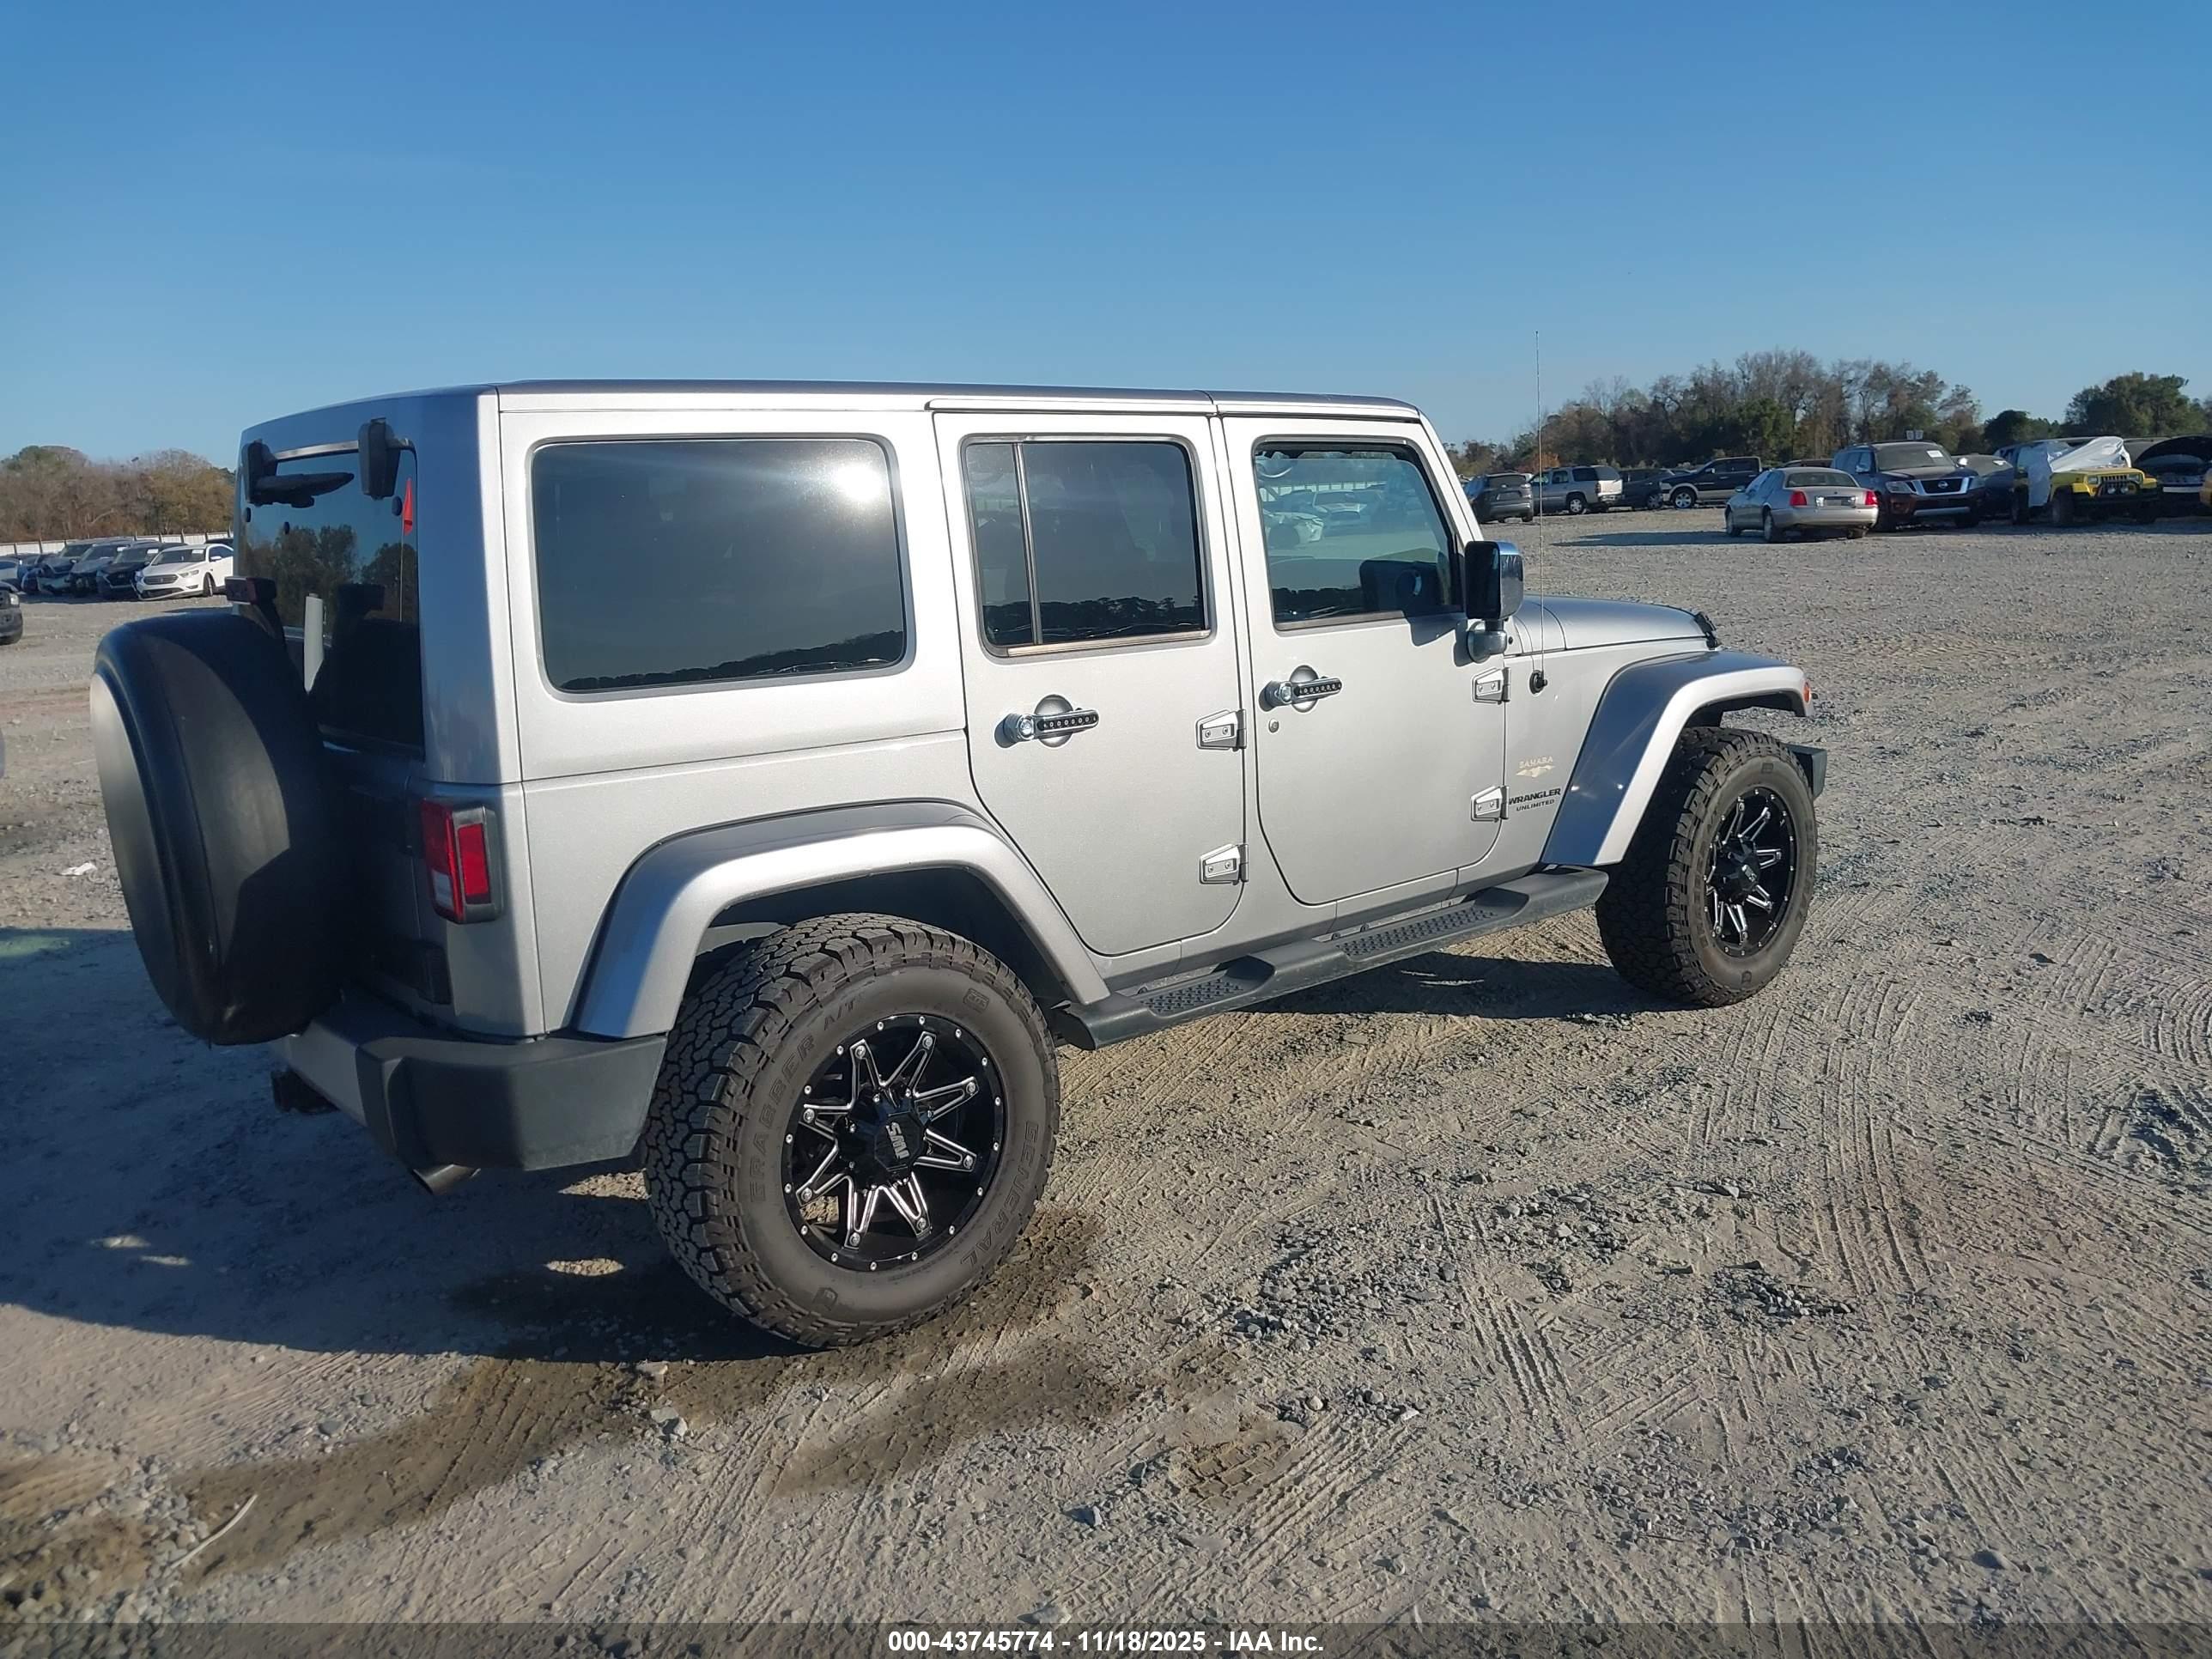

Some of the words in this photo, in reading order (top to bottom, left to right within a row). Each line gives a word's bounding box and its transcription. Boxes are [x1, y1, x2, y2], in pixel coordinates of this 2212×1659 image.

[1518, 757, 1553, 769] SAHARA
[1508, 787, 1562, 805] WRANGLER
[1516, 799, 1555, 811] UNLIMITED
[960, 1121, 1039, 1266] GENERAL
